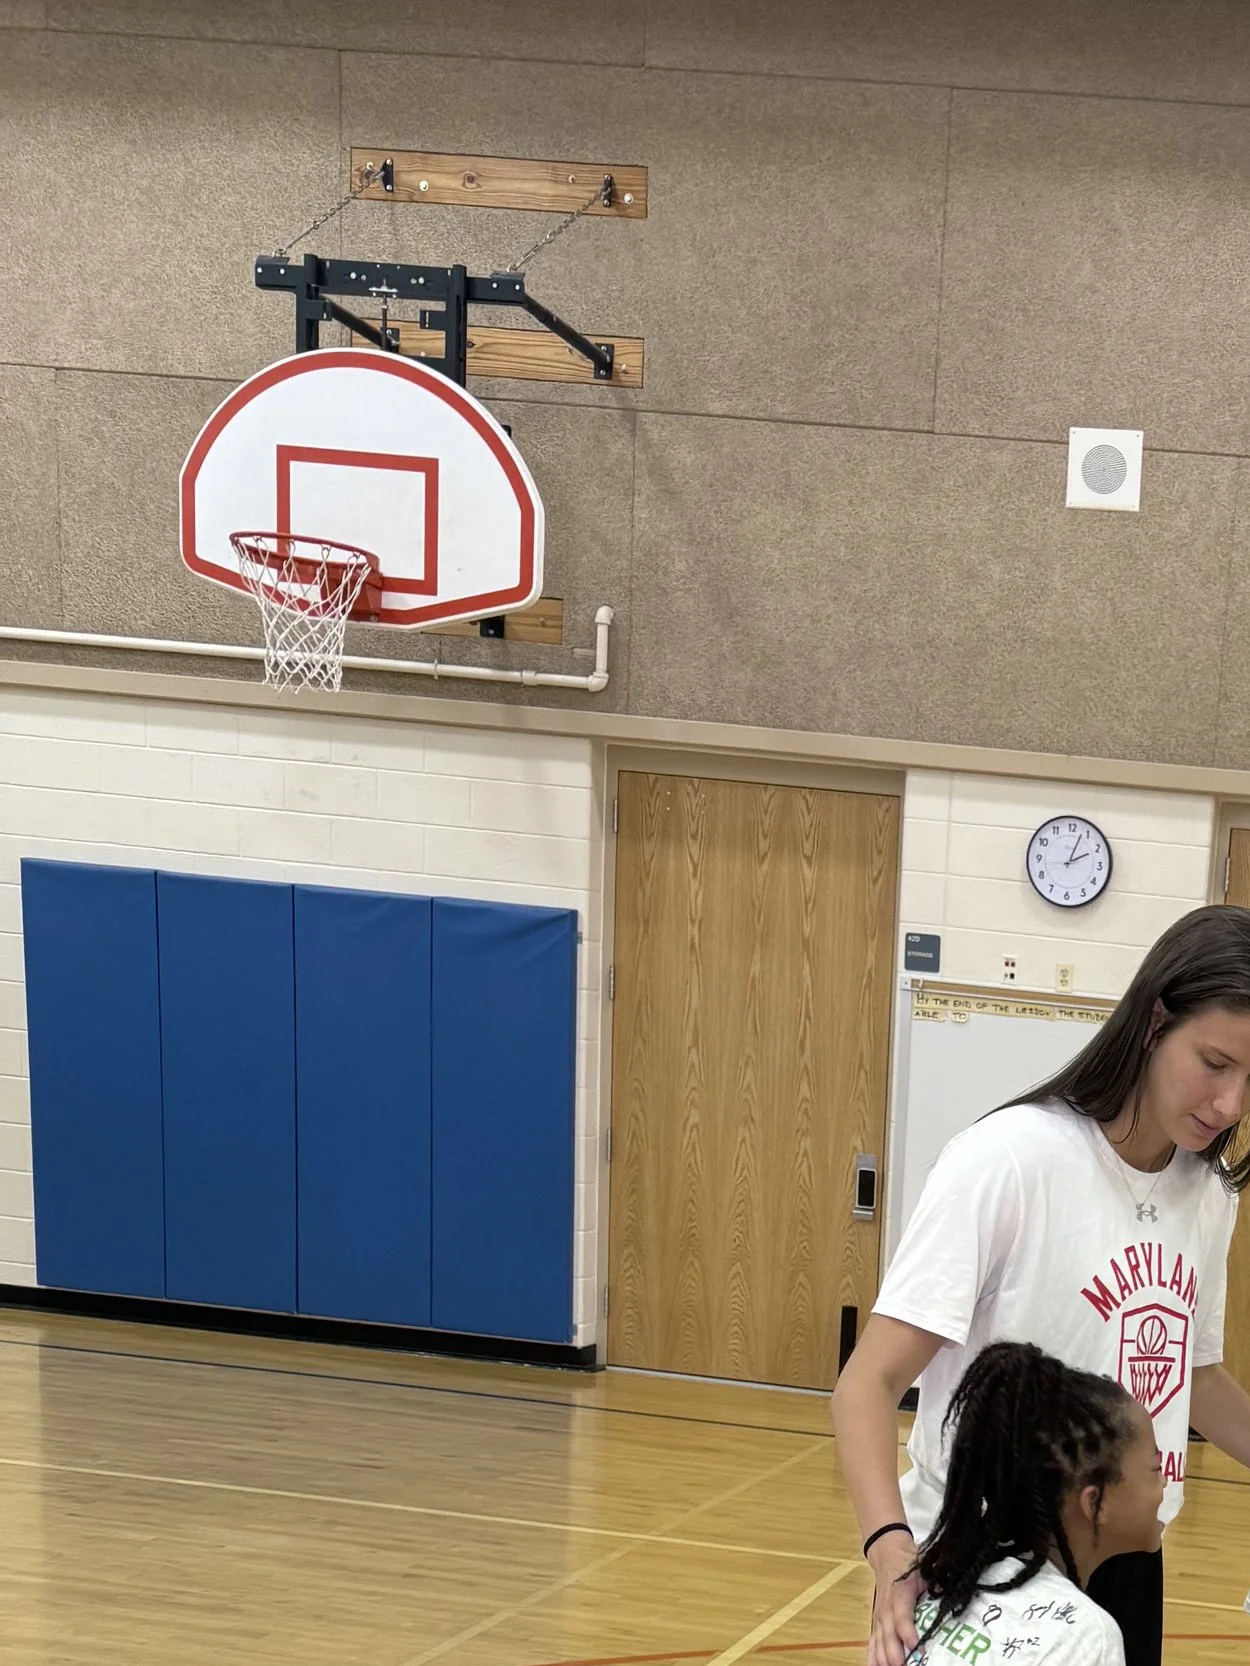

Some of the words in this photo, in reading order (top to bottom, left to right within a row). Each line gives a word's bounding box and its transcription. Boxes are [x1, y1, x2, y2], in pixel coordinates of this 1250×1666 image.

[1052, 826, 1060, 835] 11
[1068, 823, 1077, 832] 12
[1086, 830, 1090, 839] 1
[1039, 838, 1048, 847] 10
[1095, 844, 1101, 853] 2
[1036, 854, 1042, 863] 9
[1097, 862, 1103, 871] 3
[1039, 871, 1044, 879] 8
[1090, 877, 1096, 886] 4
[1049, 884, 1054, 893] 7
[1080, 888, 1086, 897] 5
[1064, 891, 1070, 900] 6
[932, 998, 949, 1006] THE
[952, 1000, 971, 1009] END
[992, 1004, 1009, 1013] THE
[1059, 1010, 1074, 1018] THE
[915, 1010, 940, 1019] ABLE
[952, 1012, 967, 1020] TO
